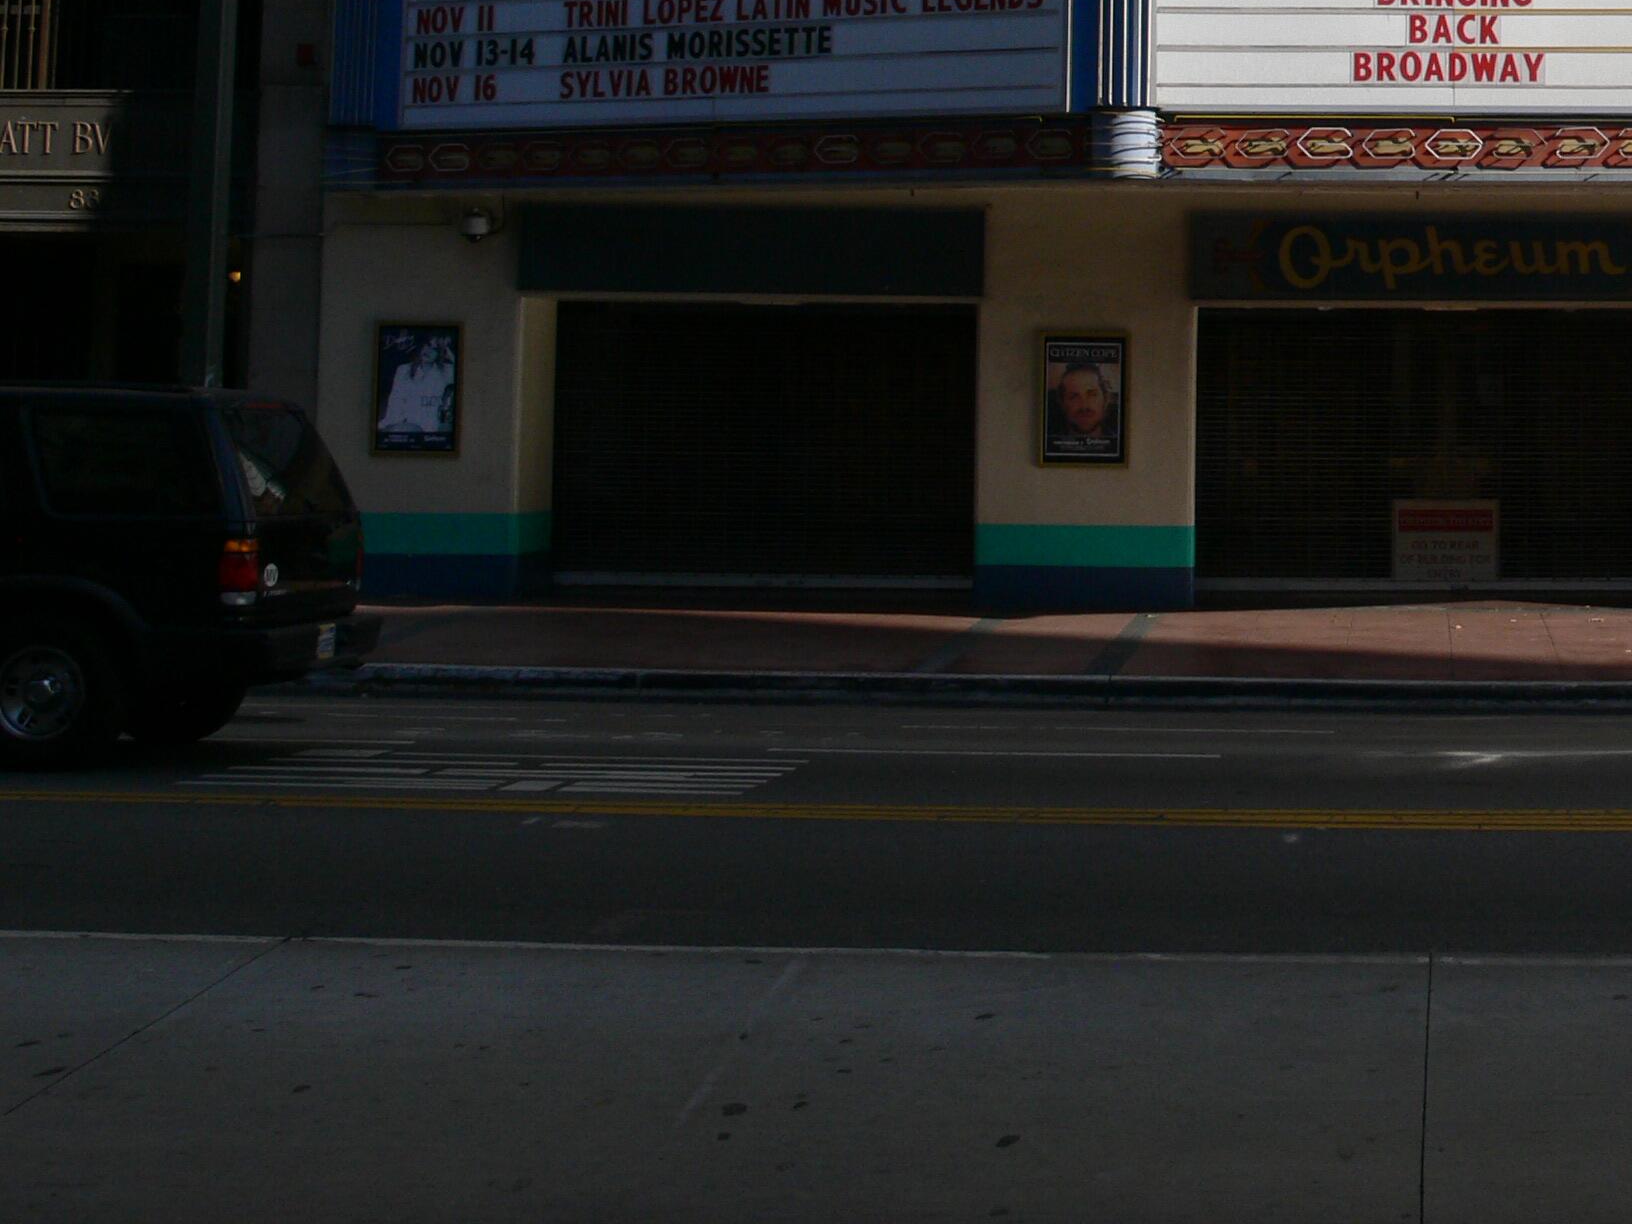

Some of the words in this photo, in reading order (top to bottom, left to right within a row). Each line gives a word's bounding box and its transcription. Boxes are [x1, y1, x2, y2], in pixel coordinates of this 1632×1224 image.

[416, 6, 465, 34] NOV
[477, 5, 495, 31] 11
[564, 0, 628, 28] TRINI
[1409, 14, 1499, 44] BACK
[414, 41, 463, 68] NOV
[476, 38, 535, 67] 13-14
[563, 33, 653, 63] ALANIS
[667, 27, 831, 60] MORISSETTE
[412, 75, 460, 104] NOV
[474, 74, 497, 101] 16
[560, 70, 650, 99] SYLVIA
[663, 65, 769, 96] BROWNE
[1353, 51, 1545, 82] BROADWAY
[1279, 224, 1629, 290] Orpheum
